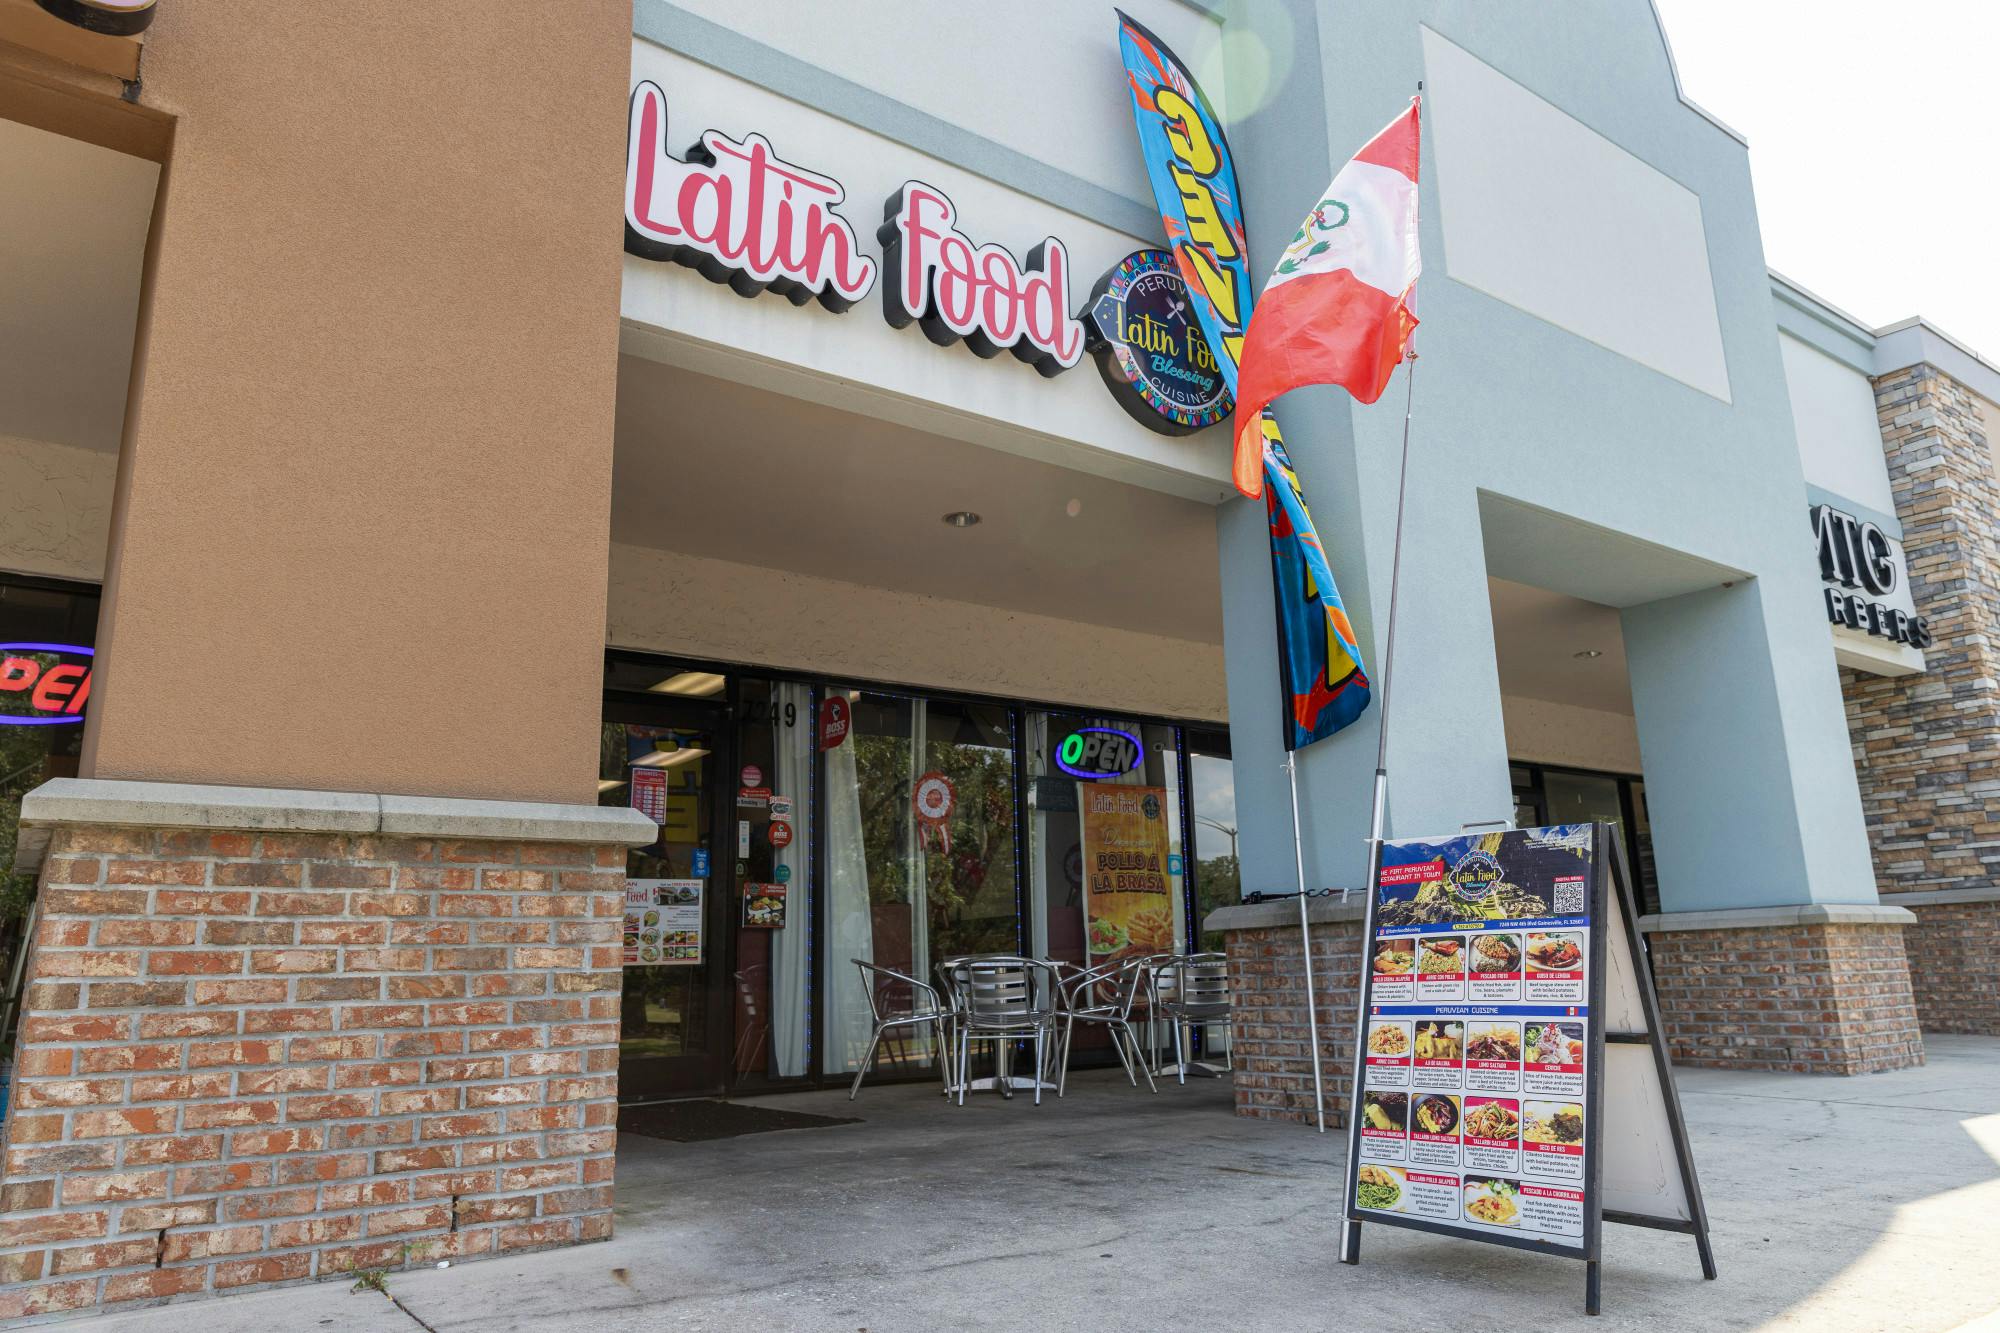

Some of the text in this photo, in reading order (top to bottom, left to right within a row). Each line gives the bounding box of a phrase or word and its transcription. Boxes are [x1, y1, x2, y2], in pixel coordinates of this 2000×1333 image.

[632, 90, 870, 293] Latin
[1136, 276, 1187, 297] PERUV
[1117, 301, 1180, 357] Latin
[1150, 354, 1215, 392] Blessing
[1151, 377, 1209, 404] CUISINE
[1824, 587, 1932, 649] RBERS
[826, 719, 846, 735] BOSS
[1062, 733, 1135, 772] OPEN
[1096, 851, 1161, 872] POLLO A
[1404, 865, 1435, 874] PERUVIAN
[1092, 873, 1167, 895] LA BRASA
[1381, 873, 1412, 883] ESTAURANT
[1456, 870, 1475, 883] Latin
